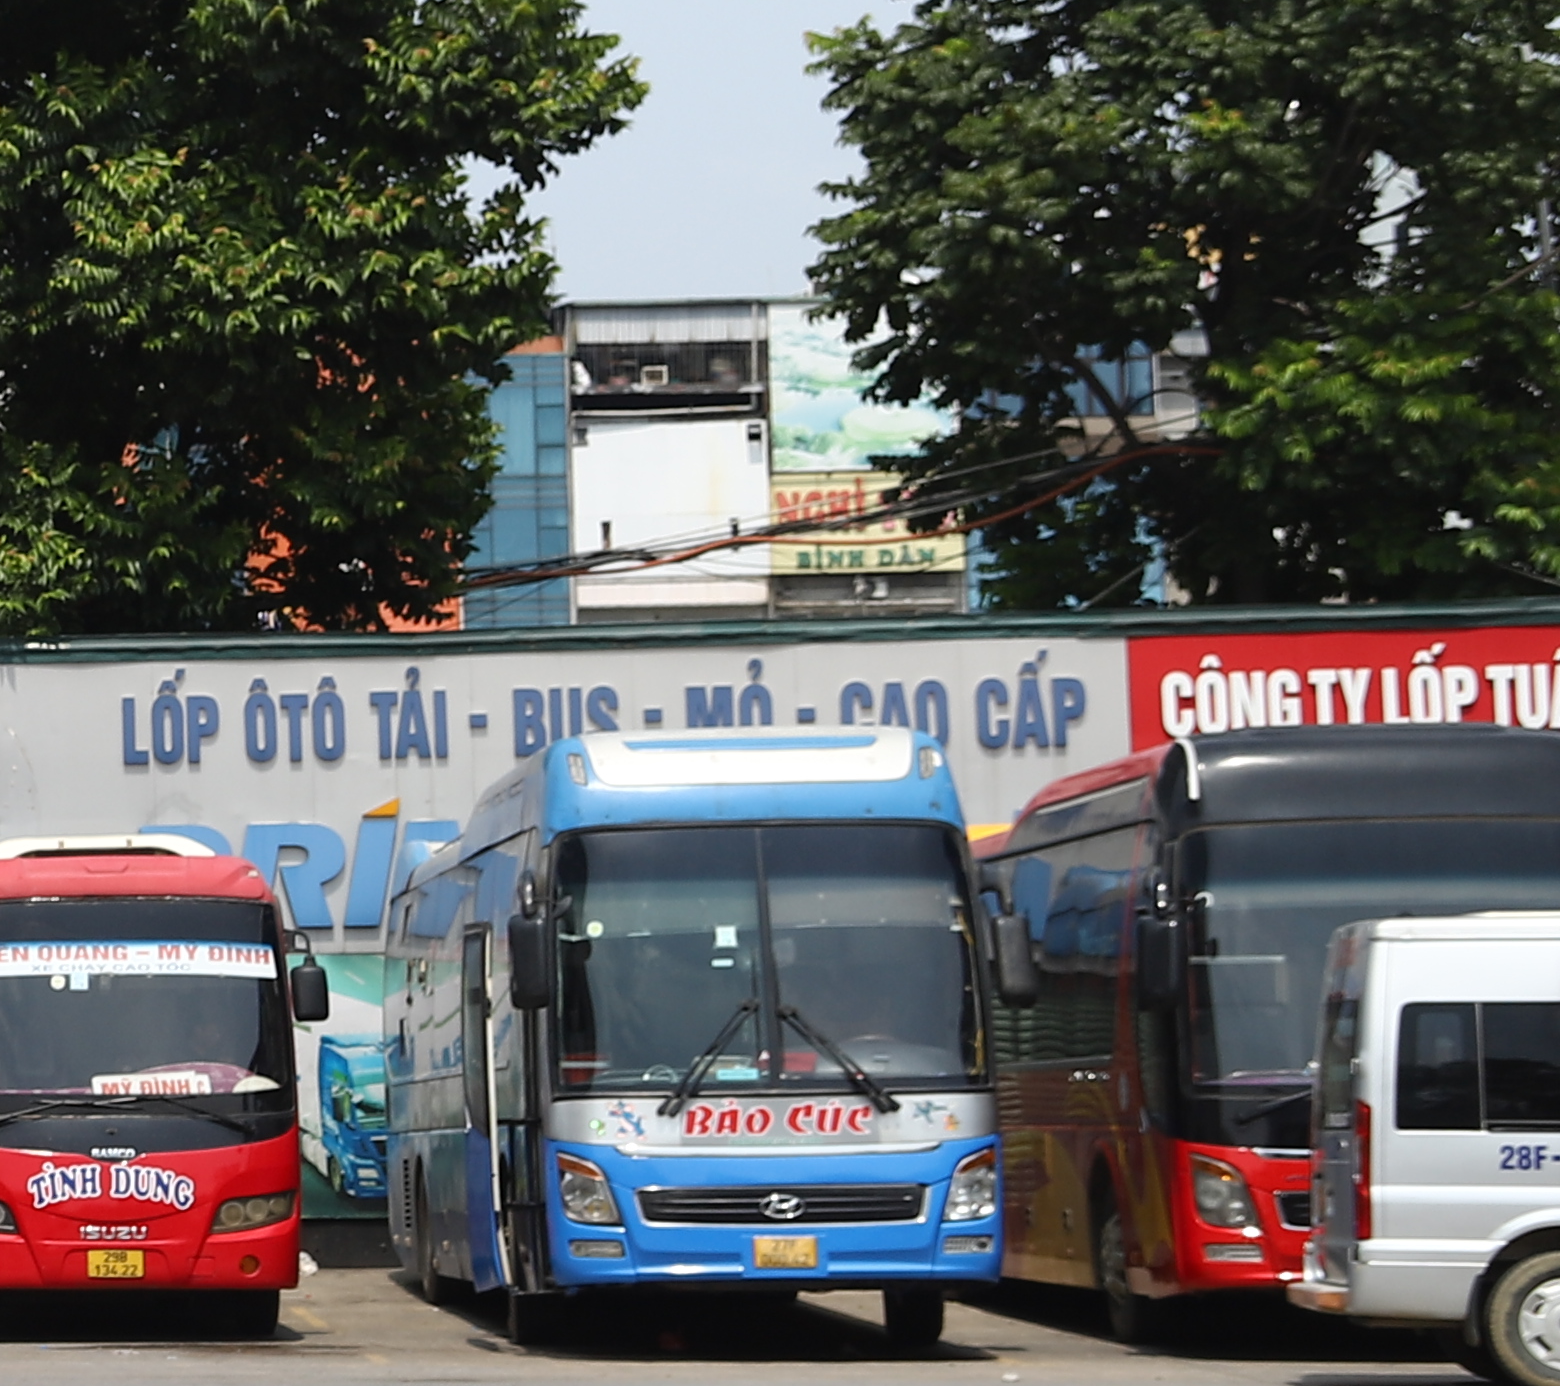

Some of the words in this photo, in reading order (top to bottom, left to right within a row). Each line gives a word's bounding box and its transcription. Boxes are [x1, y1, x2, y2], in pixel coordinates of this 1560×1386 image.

[122, 669, 219, 765] LỐP
[244, 676, 346, 762] ÔTÔ
[370, 666, 448, 760] TẢI
[513, 686, 619, 757] BUS
[975, 650, 1086, 749] CẤP
[1161, 654, 1303, 738] CÔNG
[1307, 667, 1372, 725] TY
[1380, 642, 1479, 725] LỐP
[38, 944, 128, 962] QUANG
[683, 1099, 773, 1137] BẢO
[785, 1100, 874, 1136] CÚC
[80, 1224, 148, 1241] ISUZU
